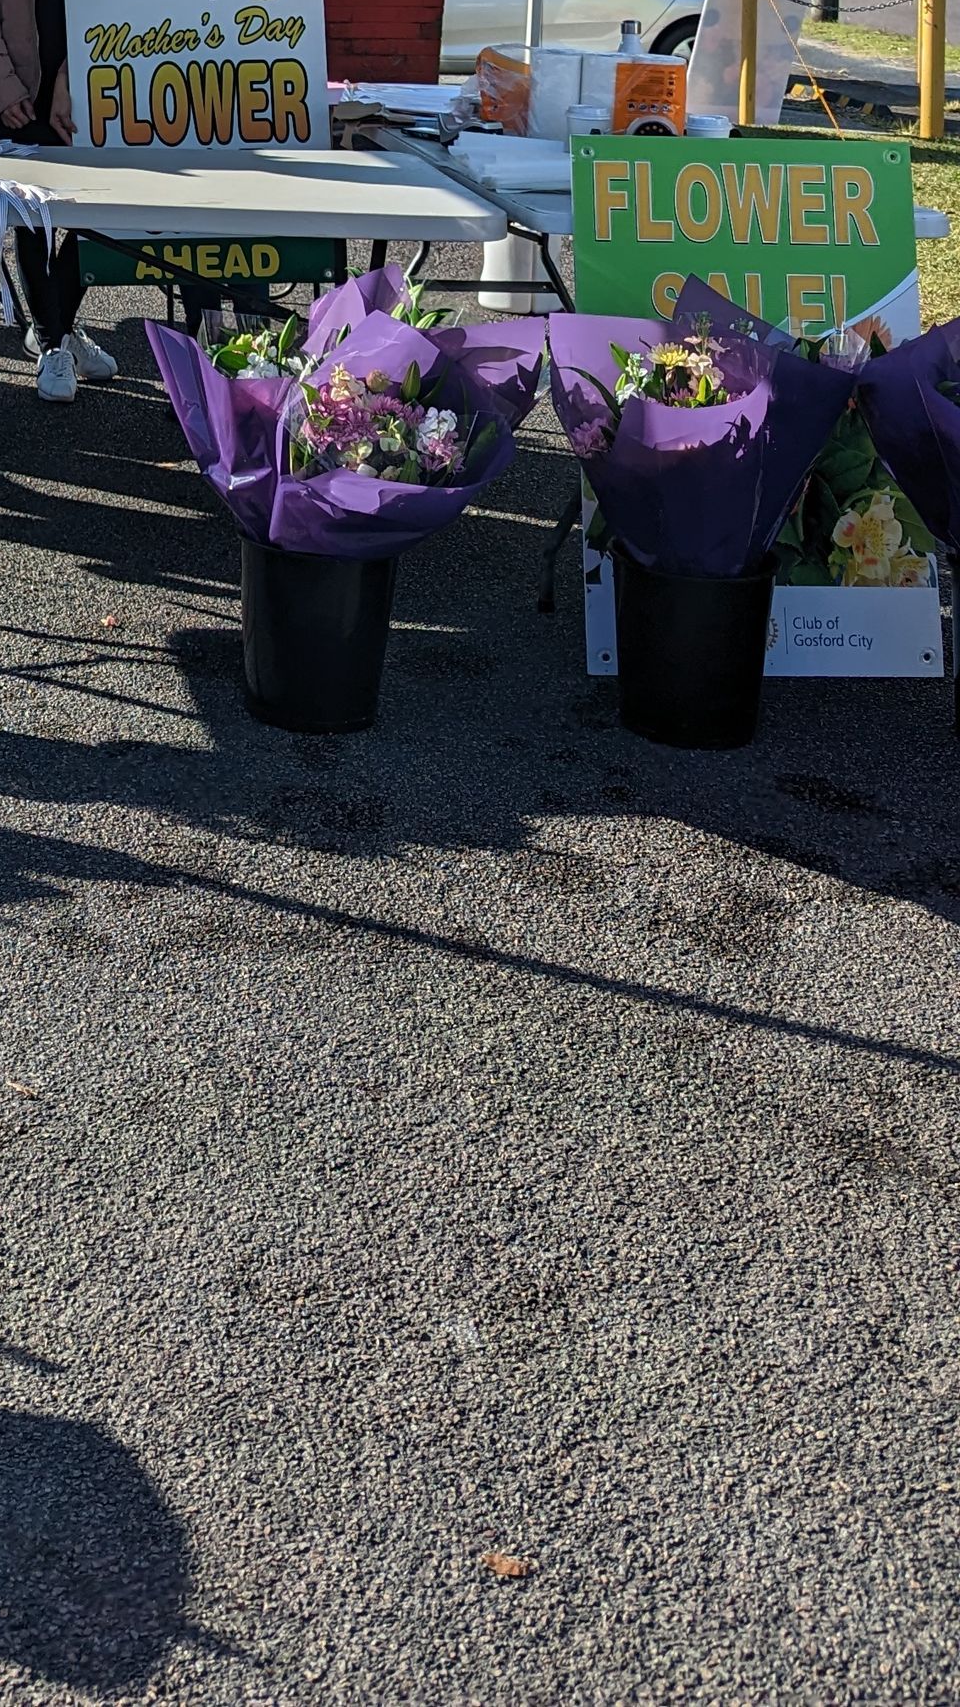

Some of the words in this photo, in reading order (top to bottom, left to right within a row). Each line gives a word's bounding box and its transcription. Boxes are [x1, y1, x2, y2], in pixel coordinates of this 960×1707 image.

[84, 11, 225, 63] Mother's
[234, 5, 307, 49] Day
[86, 57, 311, 148] FLOWER
[592, 160, 881, 246] FLOWER
[135, 244, 281, 280] AHEAD
[792, 616, 823, 630] Club
[826, 616, 841, 630] of
[793, 633, 845, 647] Gosford
[848, 634, 874, 650] City
